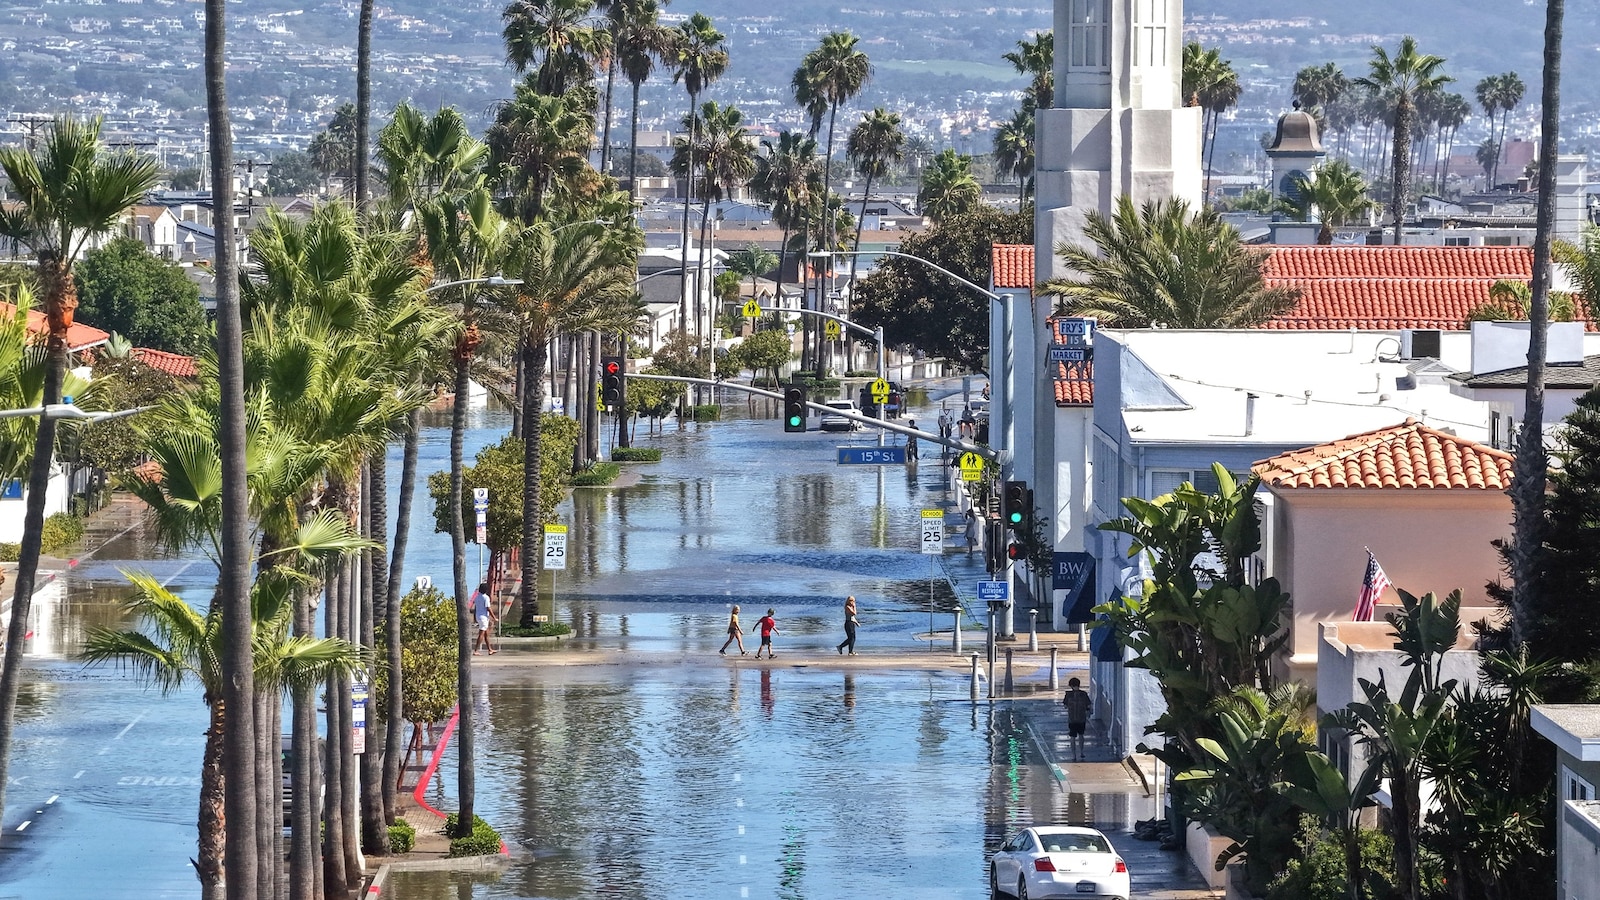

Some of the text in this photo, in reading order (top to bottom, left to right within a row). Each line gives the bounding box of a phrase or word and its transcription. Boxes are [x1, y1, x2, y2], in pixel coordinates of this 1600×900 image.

[1061, 323, 1083, 334] FRY'S
[1052, 351, 1082, 360] MARKET
[861, 451, 895, 462] 15th St
[923, 532, 941, 542] 25
[546, 546, 564, 557] 25
[1059, 562, 1084, 575] BW
